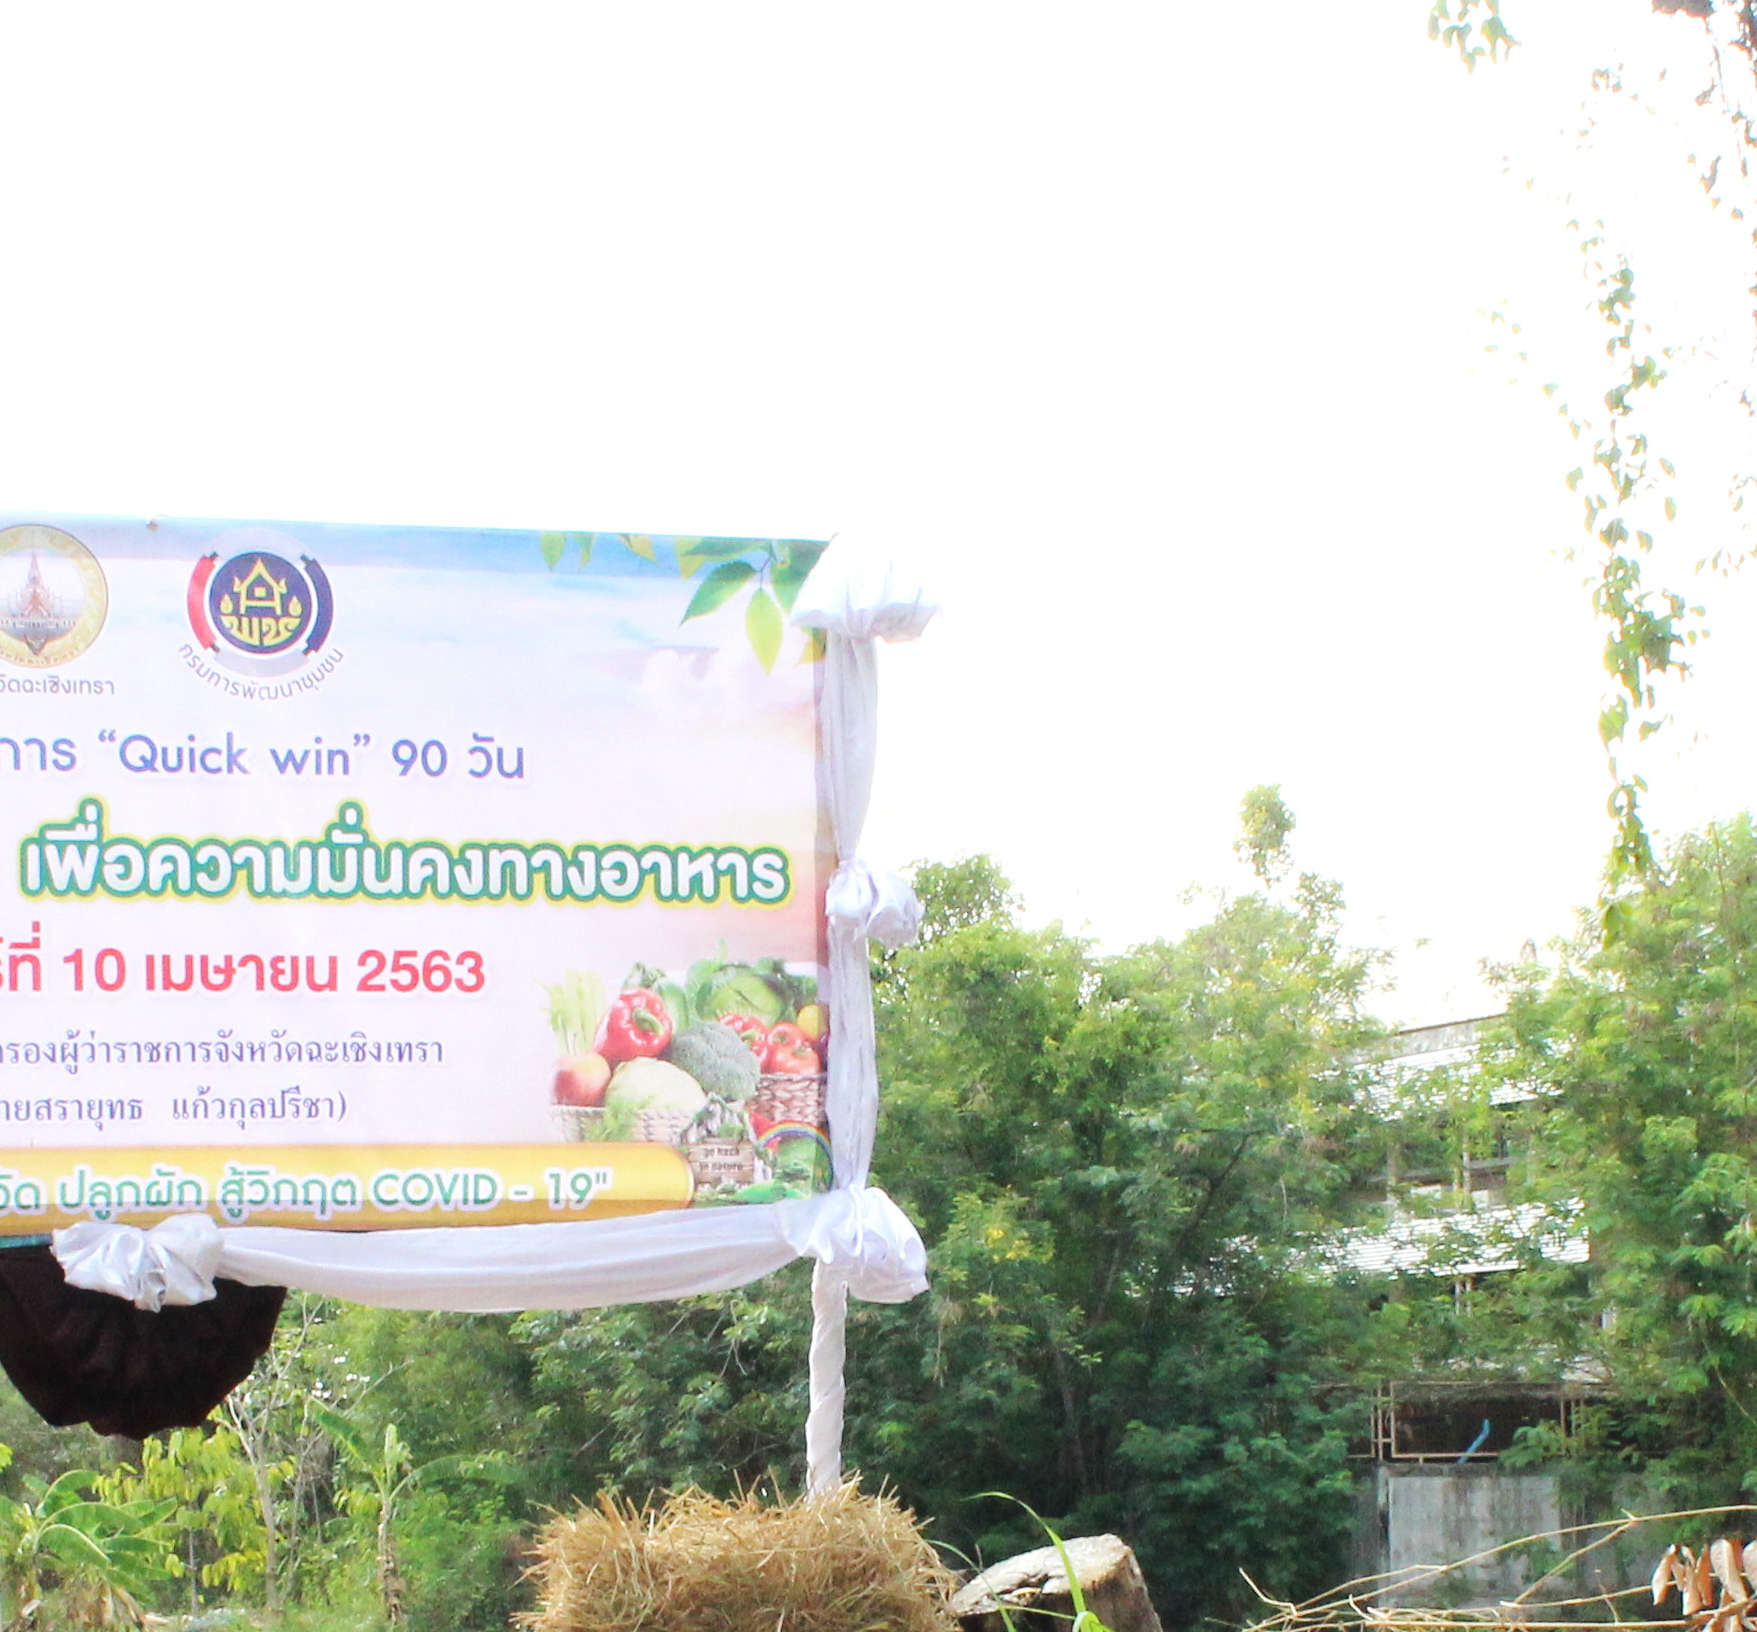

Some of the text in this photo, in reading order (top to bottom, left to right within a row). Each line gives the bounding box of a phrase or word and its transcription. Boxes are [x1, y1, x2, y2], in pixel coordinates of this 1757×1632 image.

[177, 642, 345, 700] กรมการพัฒนาชุมชน
[391, 738, 449, 778] 90
[468, 731, 526, 779] วัน
[22, 800, 790, 902] เพื่อความมั่นคงทางอาหาร
[63, 947, 127, 993] 10
[145, 950, 339, 994] เมษายน
[356, 949, 486, 994] 2563
[171, 1085, 348, 1131] แก้วกุลปรีชา)
[60, 1164, 202, 1220] ปลูกผัก
[220, 1166, 358, 1219] สู้วิกฤต
[373, 1172, 499, 1206] COVID
